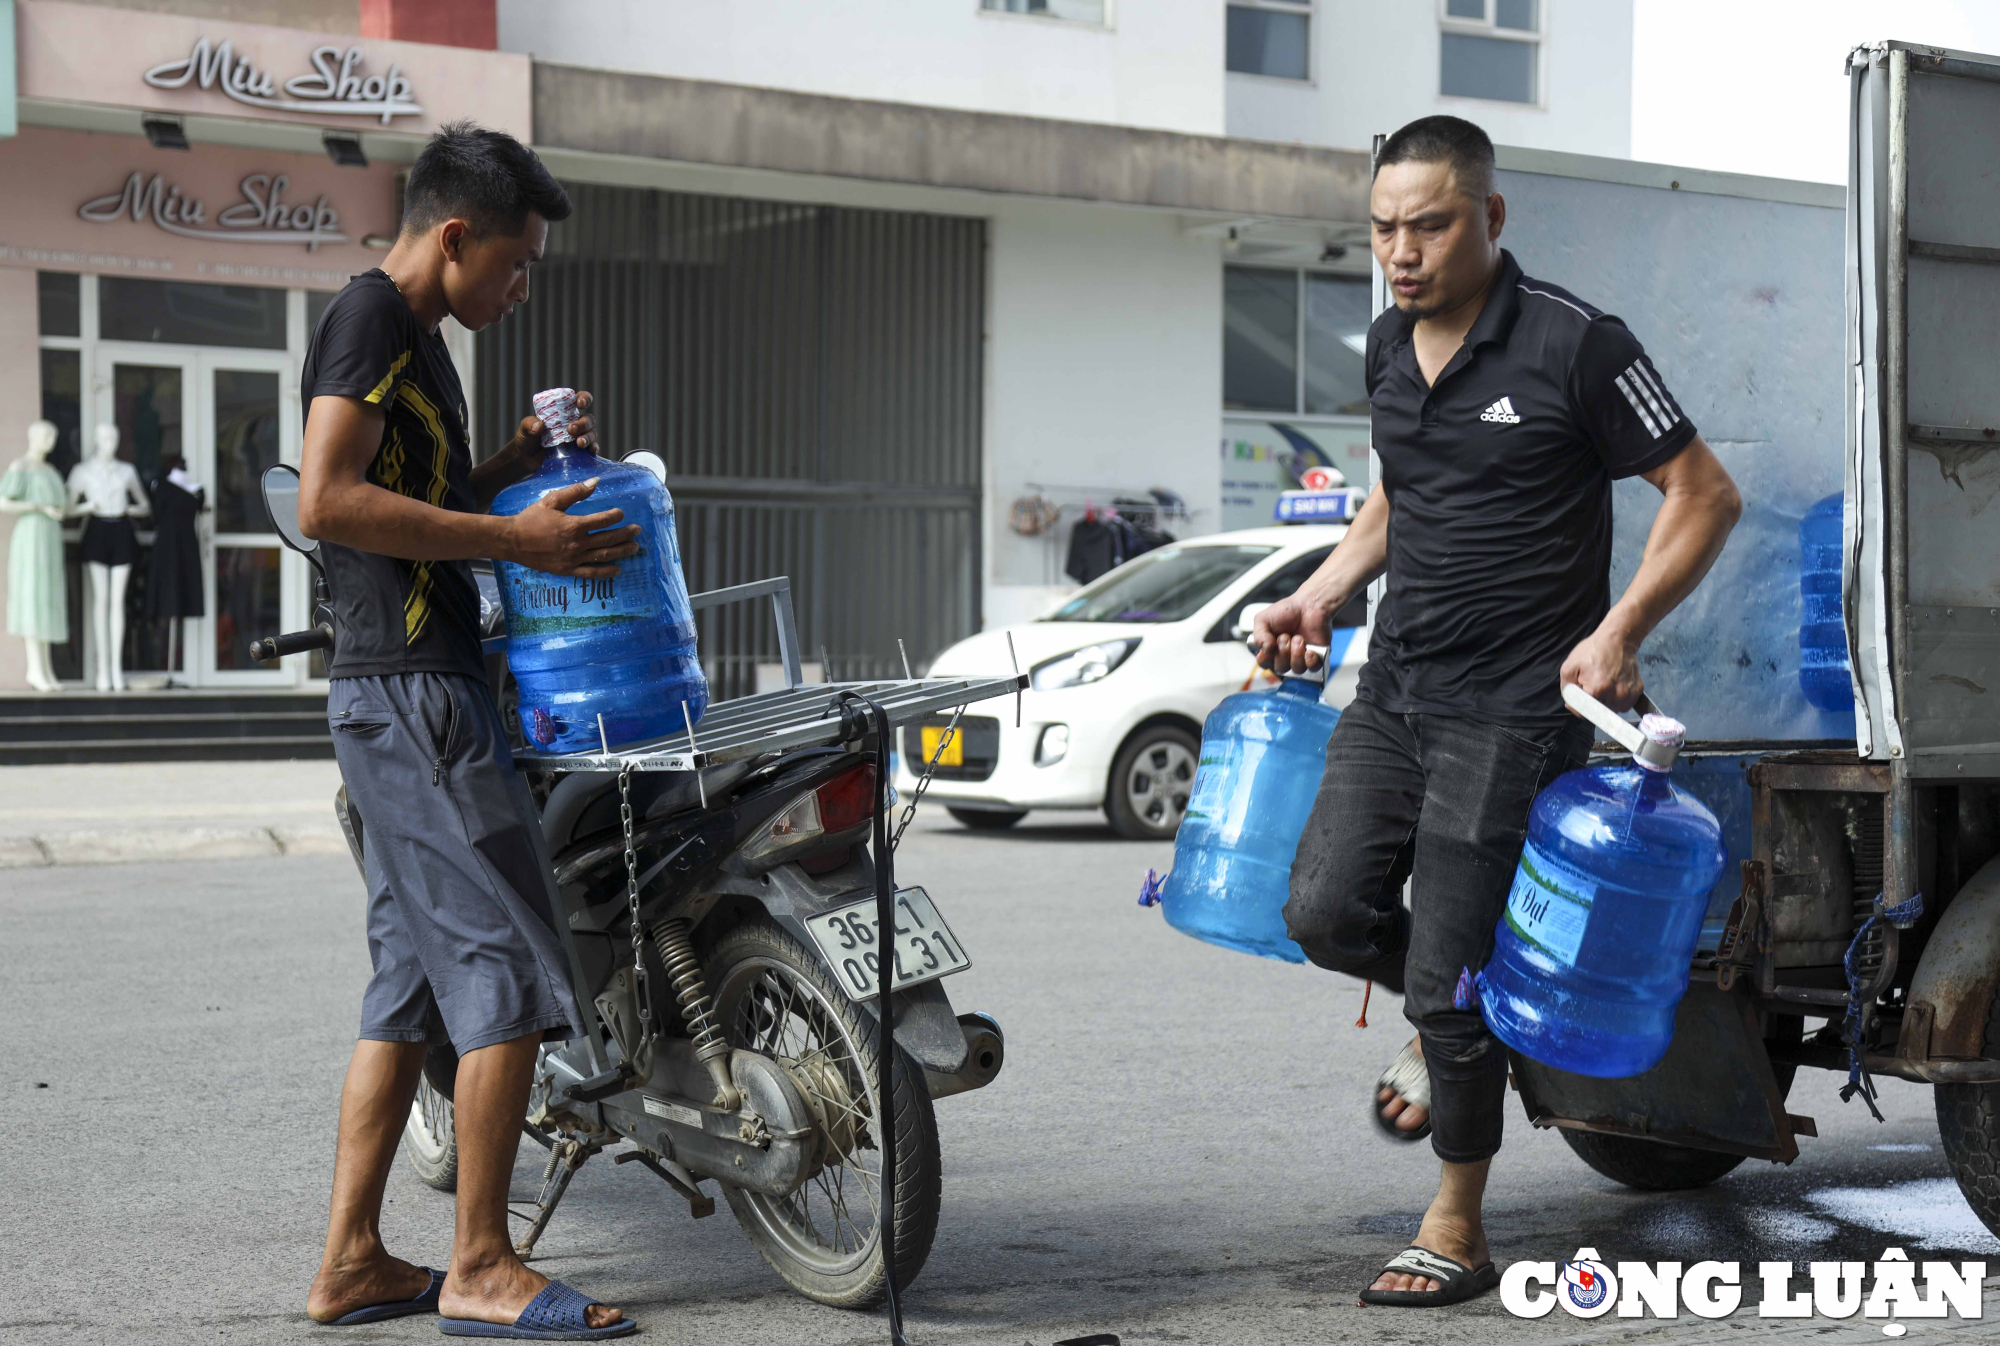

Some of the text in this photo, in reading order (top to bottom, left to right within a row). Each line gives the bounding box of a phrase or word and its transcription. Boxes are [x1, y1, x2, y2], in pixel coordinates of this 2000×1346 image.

[144, 36, 424, 124] Miu Shop
[78, 172, 348, 252] Miu Shop
[1480, 412, 1520, 424] adidas
[1521, 882, 1550, 927] Đạt
